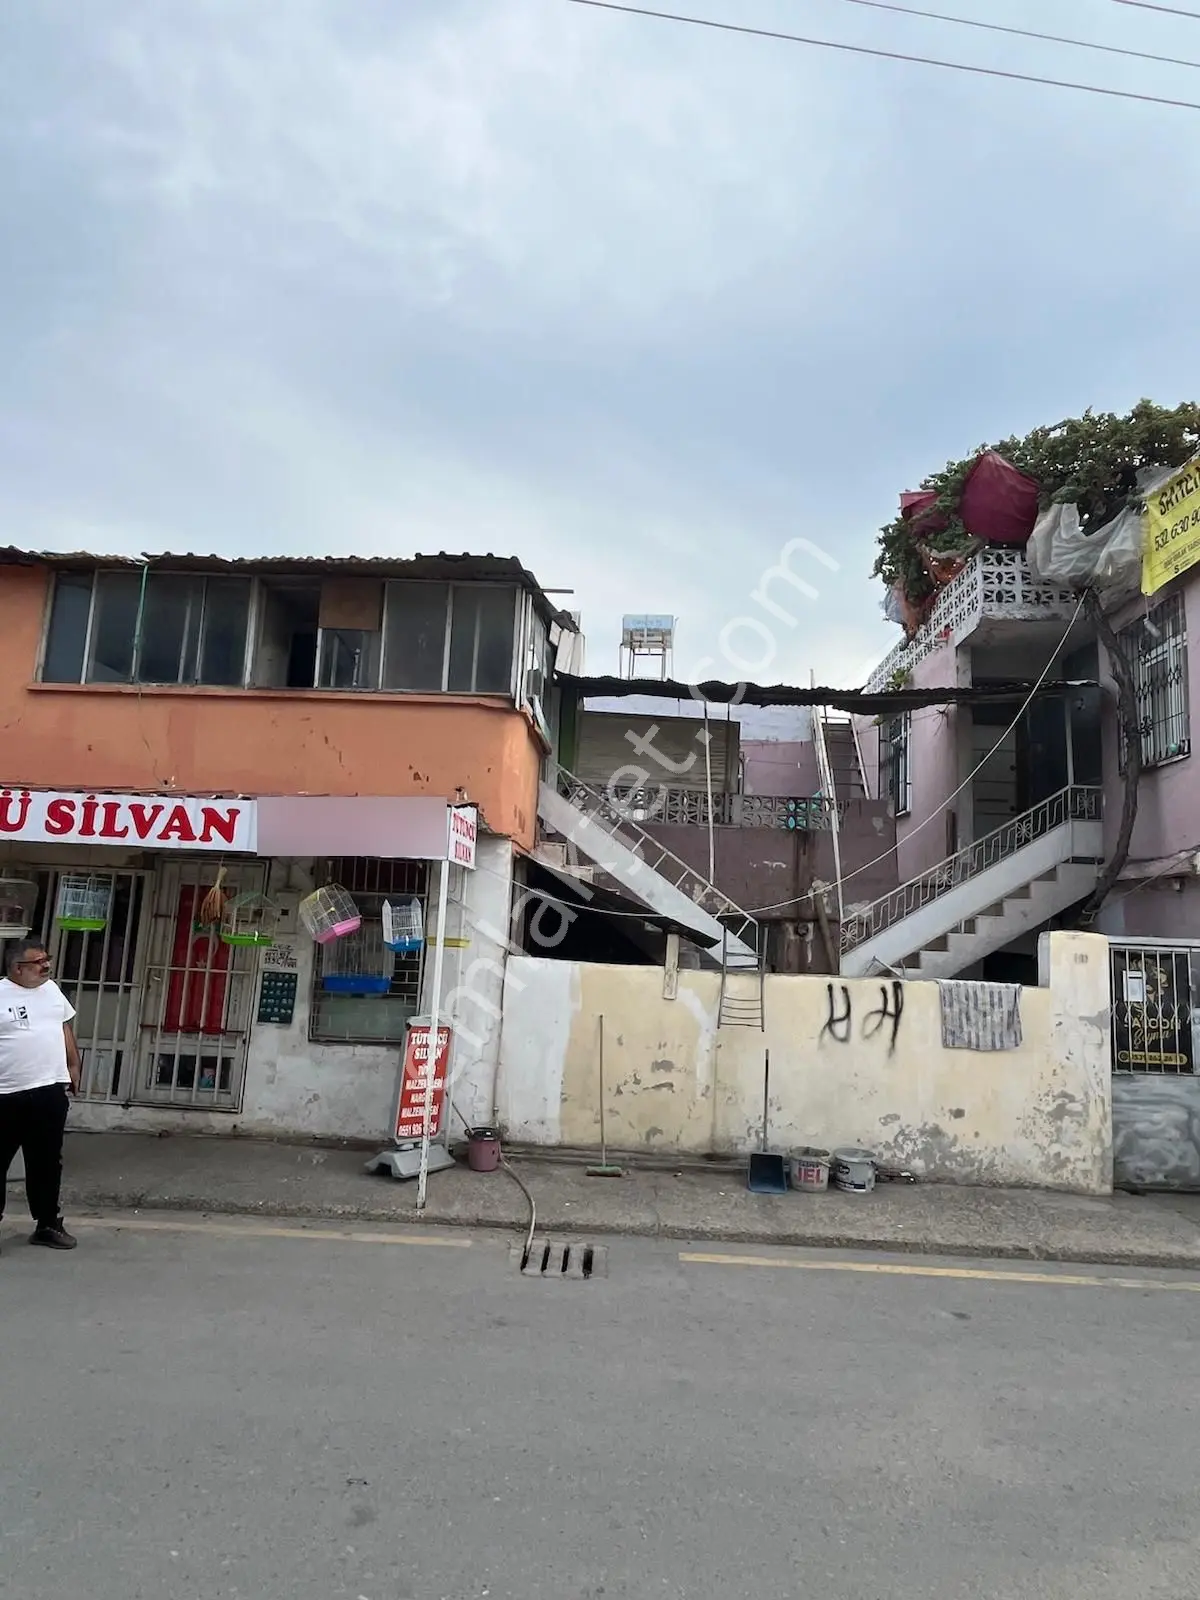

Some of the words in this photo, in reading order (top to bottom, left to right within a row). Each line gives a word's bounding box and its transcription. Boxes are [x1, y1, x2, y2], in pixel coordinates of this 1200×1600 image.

[45, 795, 240, 843] SİLVAN
[1124, 1018, 1181, 1030] SAOON
[411, 1030, 449, 1045] TÜTCÜ
